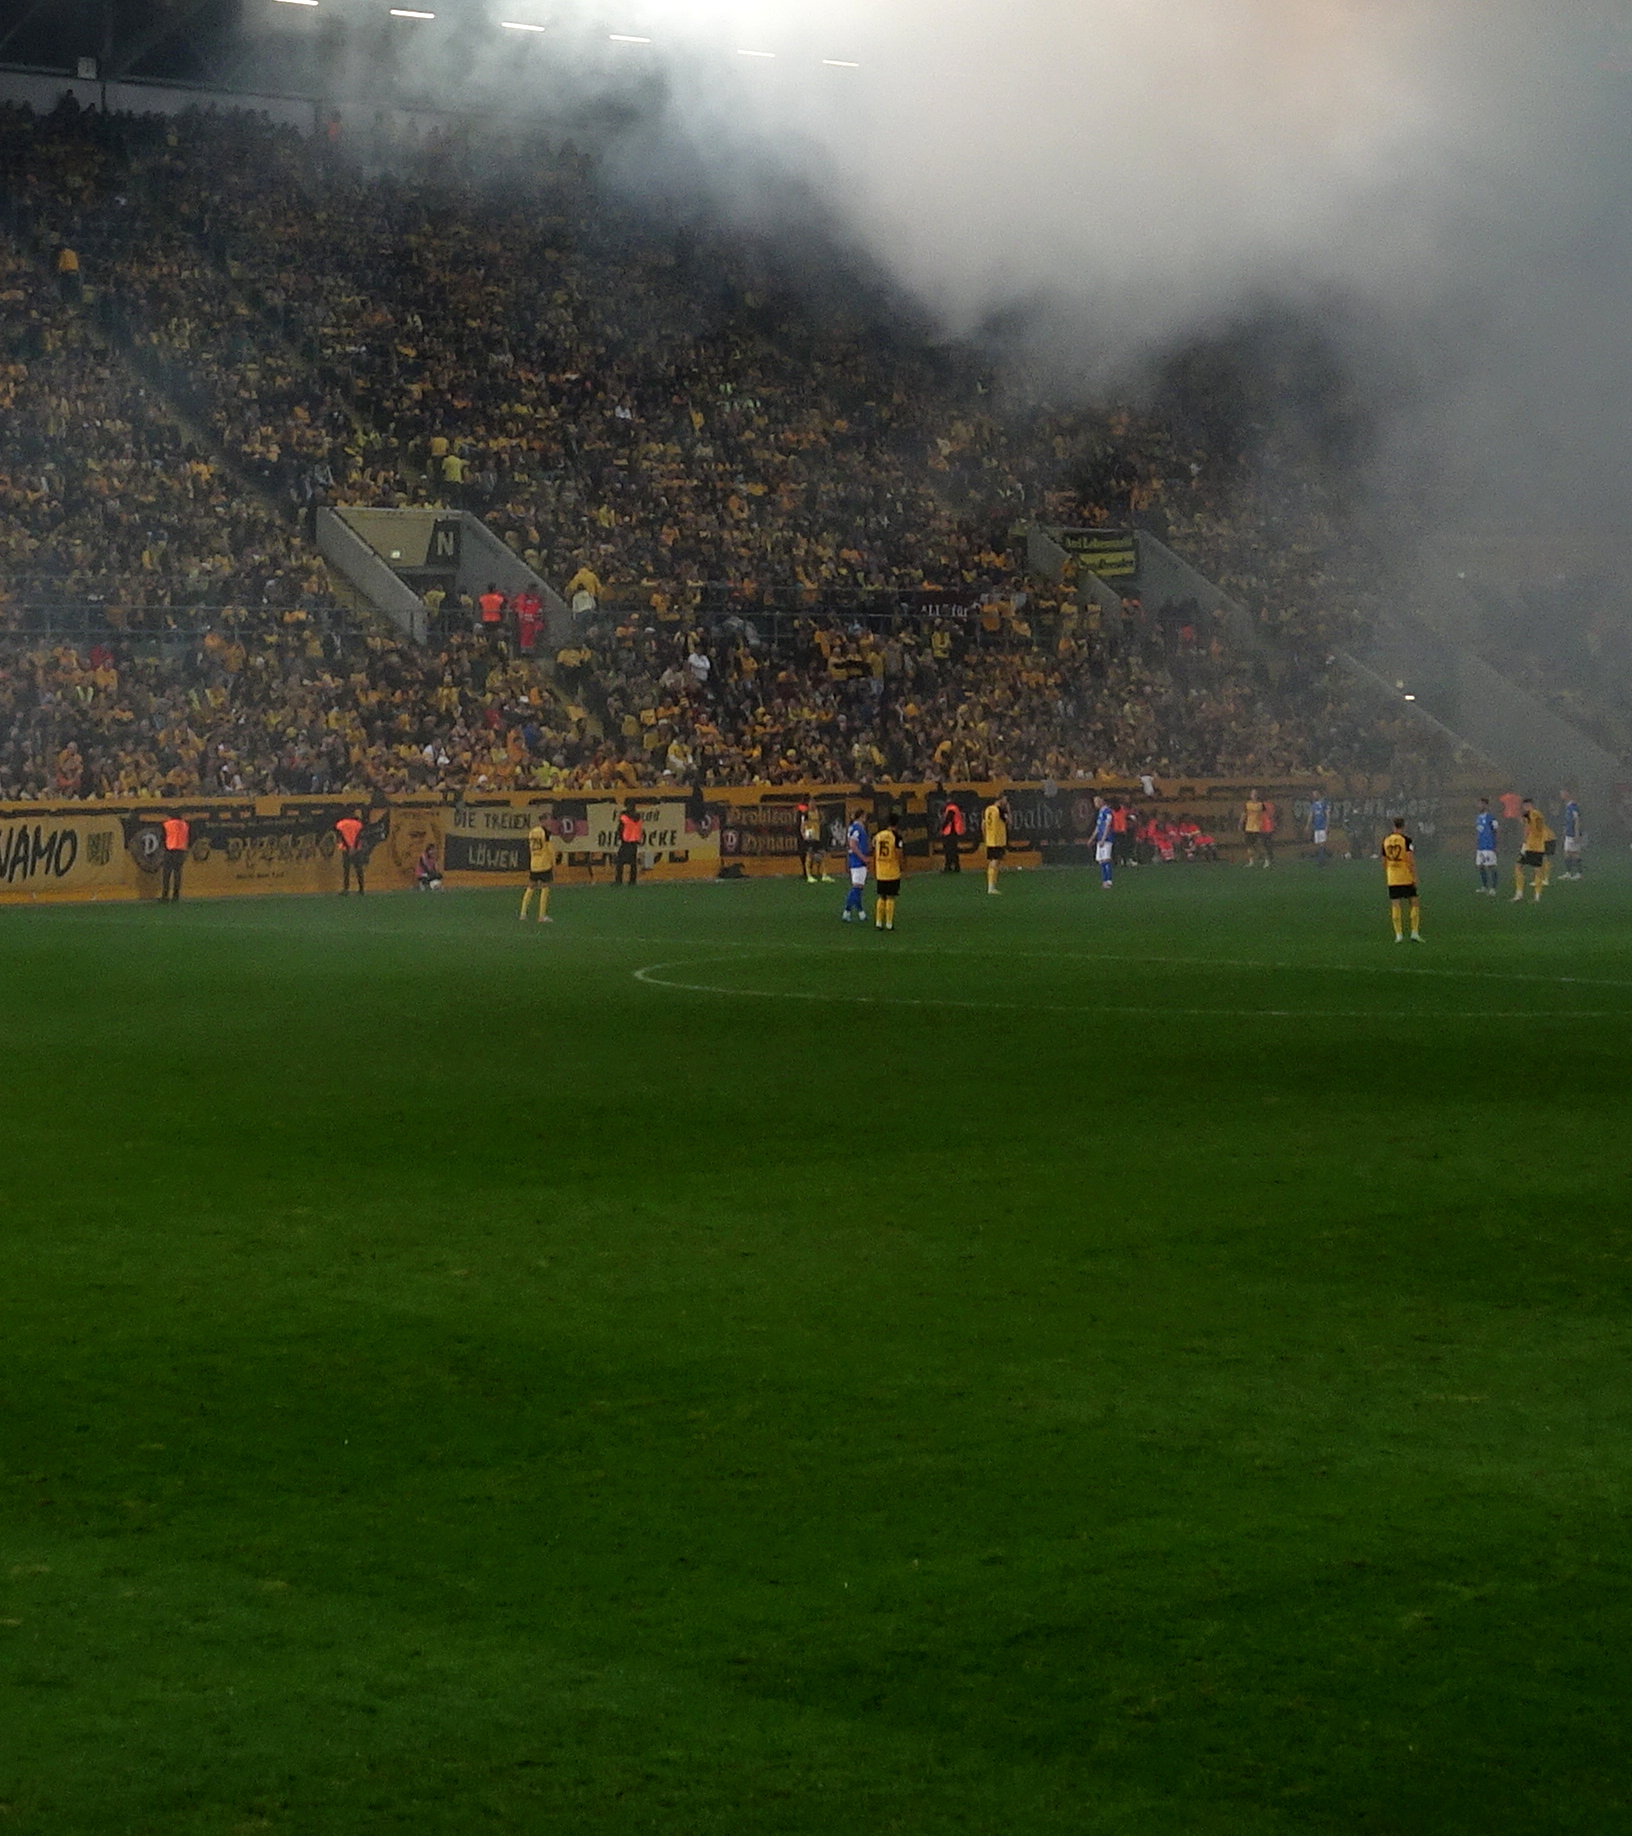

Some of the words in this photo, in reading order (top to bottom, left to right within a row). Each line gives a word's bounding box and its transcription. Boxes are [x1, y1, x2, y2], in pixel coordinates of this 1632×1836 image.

[436, 531, 455, 556] N
[453, 810, 475, 829] DIE
[484, 811, 532, 829] TREUEN
[741, 833, 799, 854] Dynam
[467, 843, 520, 867] LÖWEN
